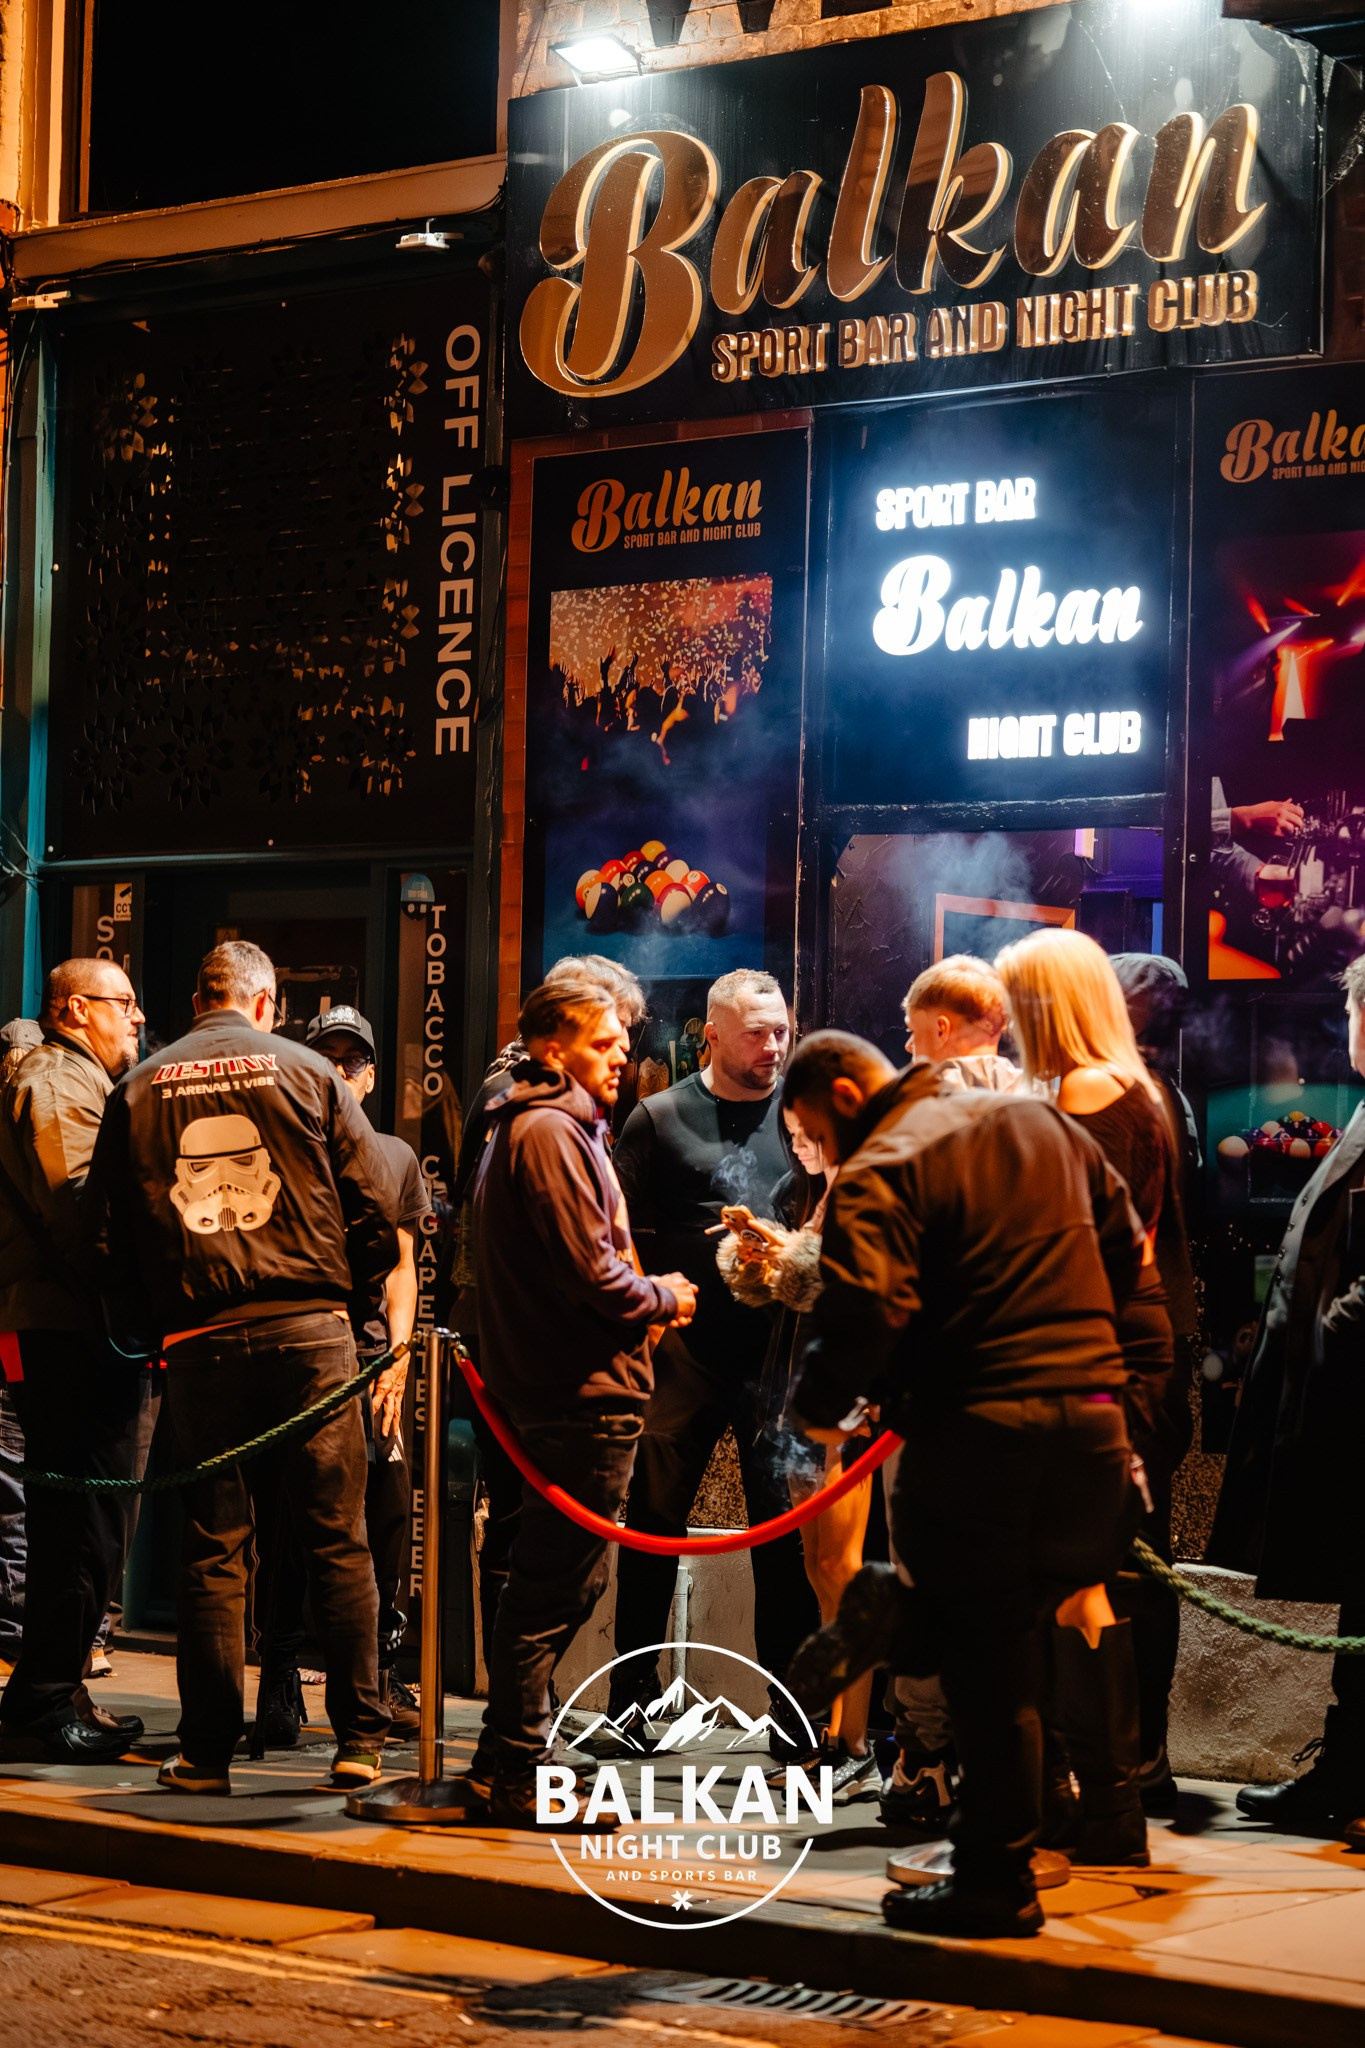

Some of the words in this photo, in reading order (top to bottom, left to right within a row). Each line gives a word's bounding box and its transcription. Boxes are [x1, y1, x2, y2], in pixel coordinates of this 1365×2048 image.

[519, 71, 1268, 398] Balkan
[711, 322, 830, 383] SPORT
[838, 313, 917, 368] BAR
[925, 300, 1006, 358] AND
[1016, 284, 1138, 347] NIGHT
[1147, 270, 1258, 332] CLUB
[444, 324, 481, 449] OFF
[571, 467, 763, 553] Balkan
[876, 482, 969, 531] SPORT
[975, 477, 1036, 523] BAR
[1272, 466, 1302, 480] SPORT
[1305, 464, 1325, 477] BAR
[1327, 462, 1347, 475] AND
[623, 532, 654, 549] SPORT
[657, 530, 677, 546] BAR
[680, 528, 700, 544] AND
[703, 525, 732, 542] NIGHT
[735, 522, 761, 538] CLUB
[434, 473, 478, 755] LICENCE
[873, 555, 1143, 656] Balkan
[967, 714, 1057, 760] NIGHT
[1063, 711, 1142, 756] CLUB
[423, 905, 447, 1097] TOBACCO
[151, 1054, 279, 1085] DESTINY
[162, 1088, 172, 1099] 3
[175, 1080, 231, 1097] ARENAS
[232, 1081, 241, 1090] 1
[243, 1076, 275, 1089] VIBE
